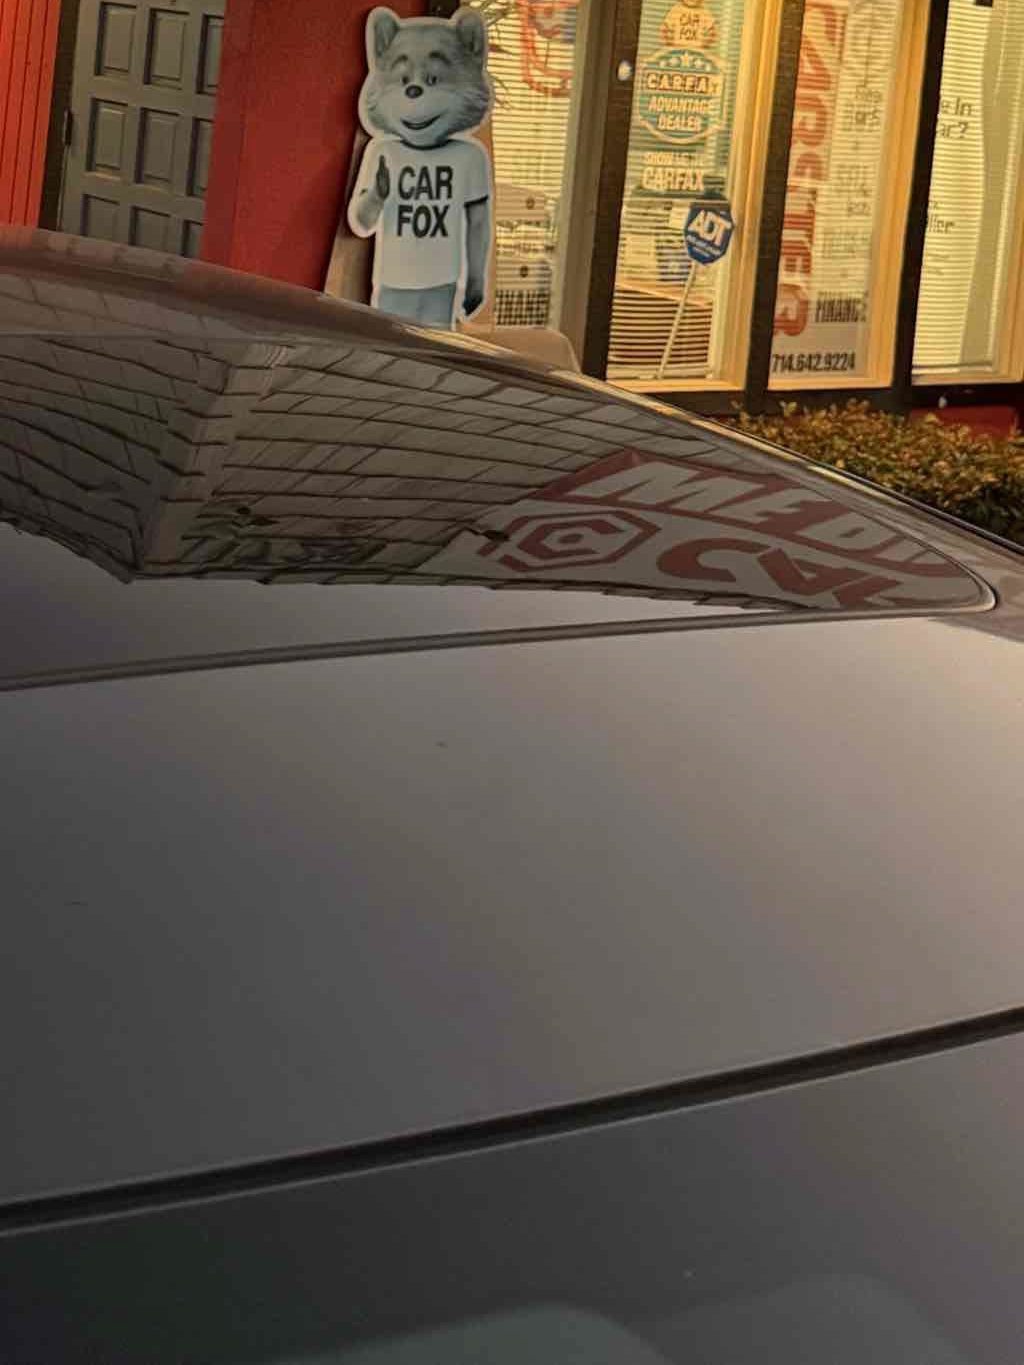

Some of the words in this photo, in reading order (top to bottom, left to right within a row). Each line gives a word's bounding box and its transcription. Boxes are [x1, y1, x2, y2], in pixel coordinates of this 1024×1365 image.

[398, 165, 454, 201] CAR
[641, 167, 705, 192] CARFAX
[397, 204, 451, 238] FOX
[687, 208, 733, 247] ADT
[772, 352, 857, 374] 714.642.9224
